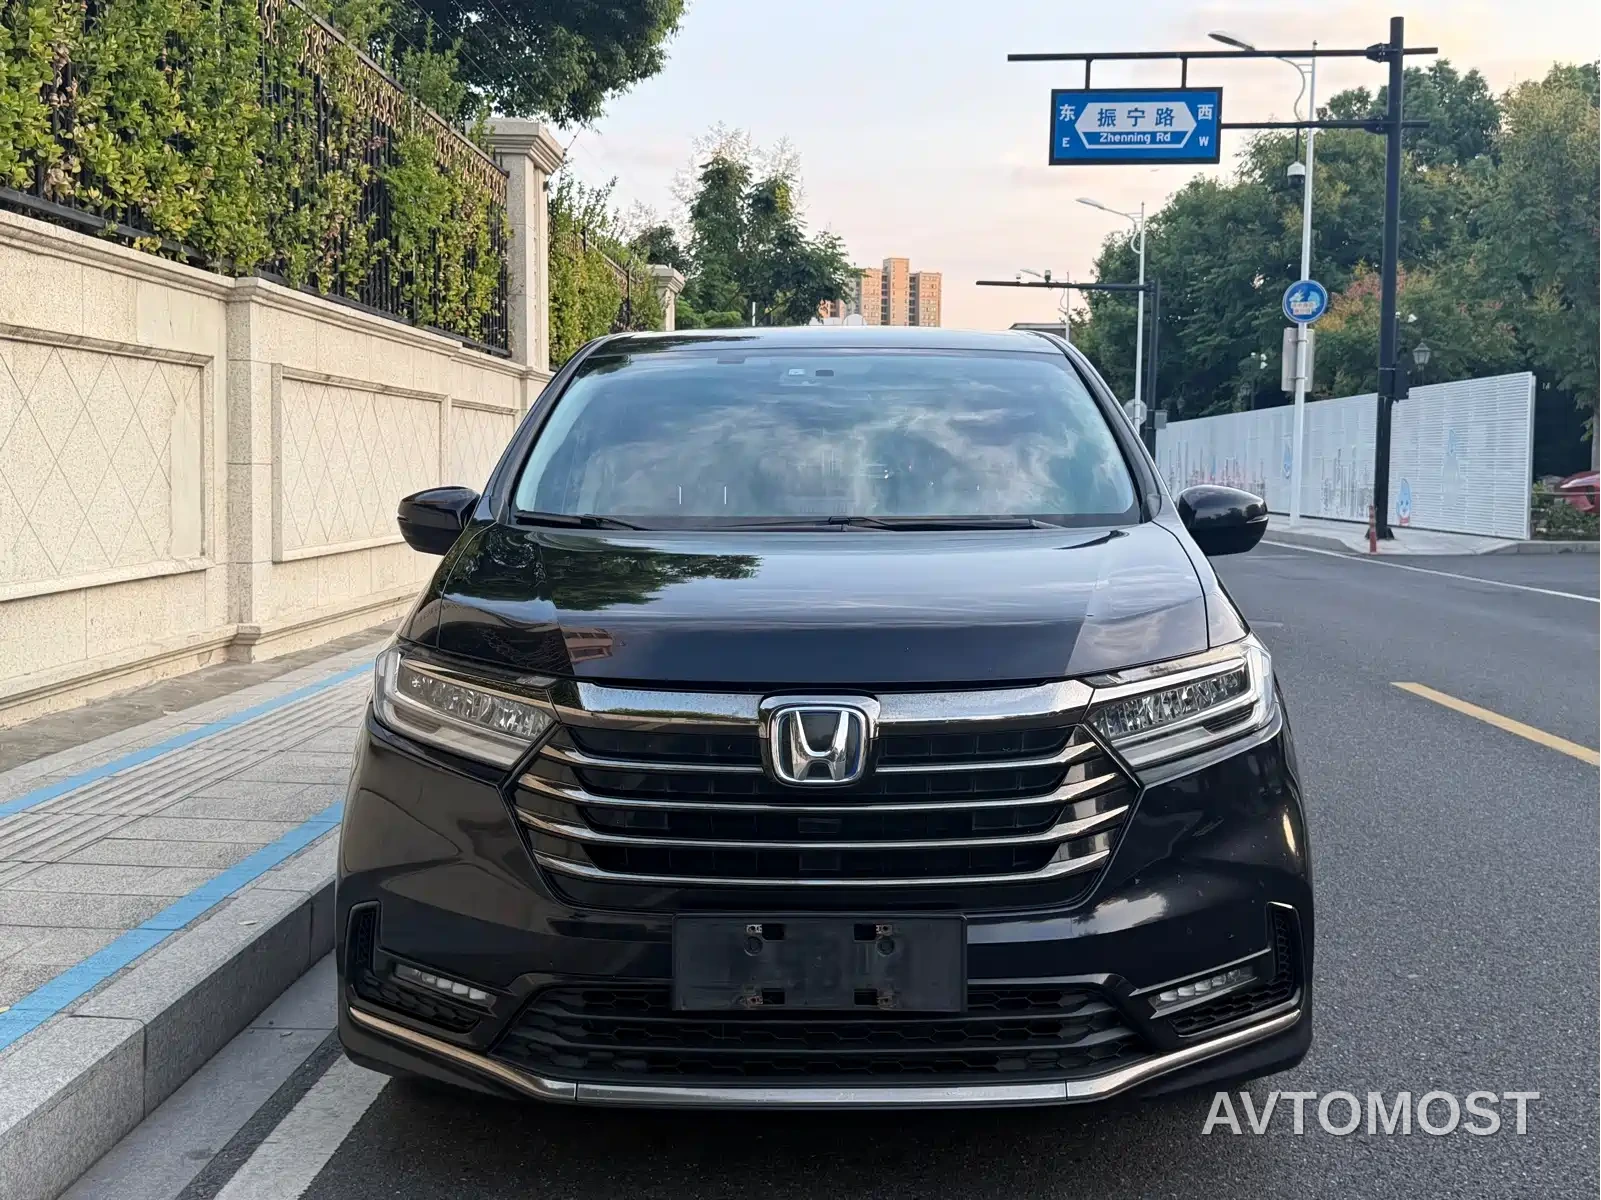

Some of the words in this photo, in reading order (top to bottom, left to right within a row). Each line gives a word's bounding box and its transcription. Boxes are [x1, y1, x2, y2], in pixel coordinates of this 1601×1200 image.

[1059, 104, 1076, 121] 东
[1097, 107, 1175, 127] 振宁路
[1197, 104, 1213, 120] 西
[1062, 137, 1070, 147] E
[1099, 133, 1151, 144] Zhenning
[1156, 132, 1171, 142] Rd
[1199, 136, 1209, 146] W
